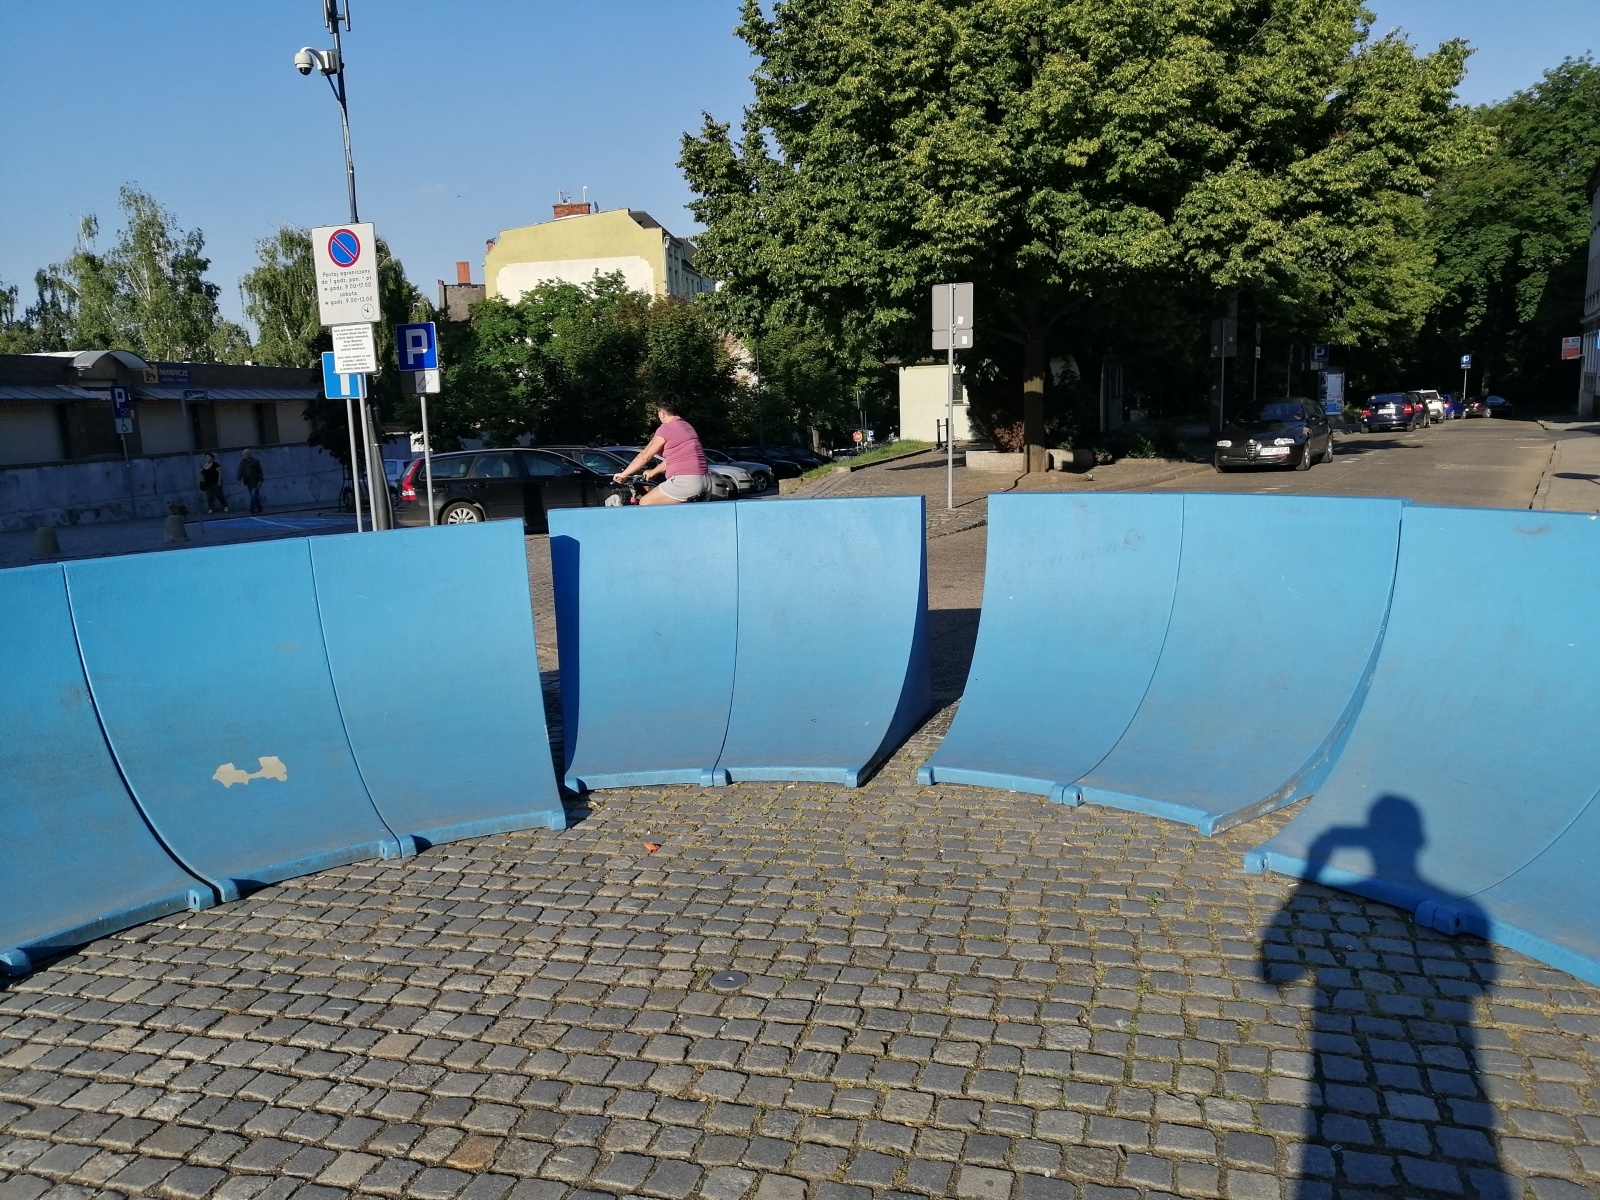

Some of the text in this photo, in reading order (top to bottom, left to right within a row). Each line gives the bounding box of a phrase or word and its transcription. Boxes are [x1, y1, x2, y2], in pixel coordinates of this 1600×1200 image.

[340, 269, 370, 277] ograniczony
[405, 329, 428, 365] P
[1463, 355, 1470, 364] P
[114, 387, 126, 409] P
